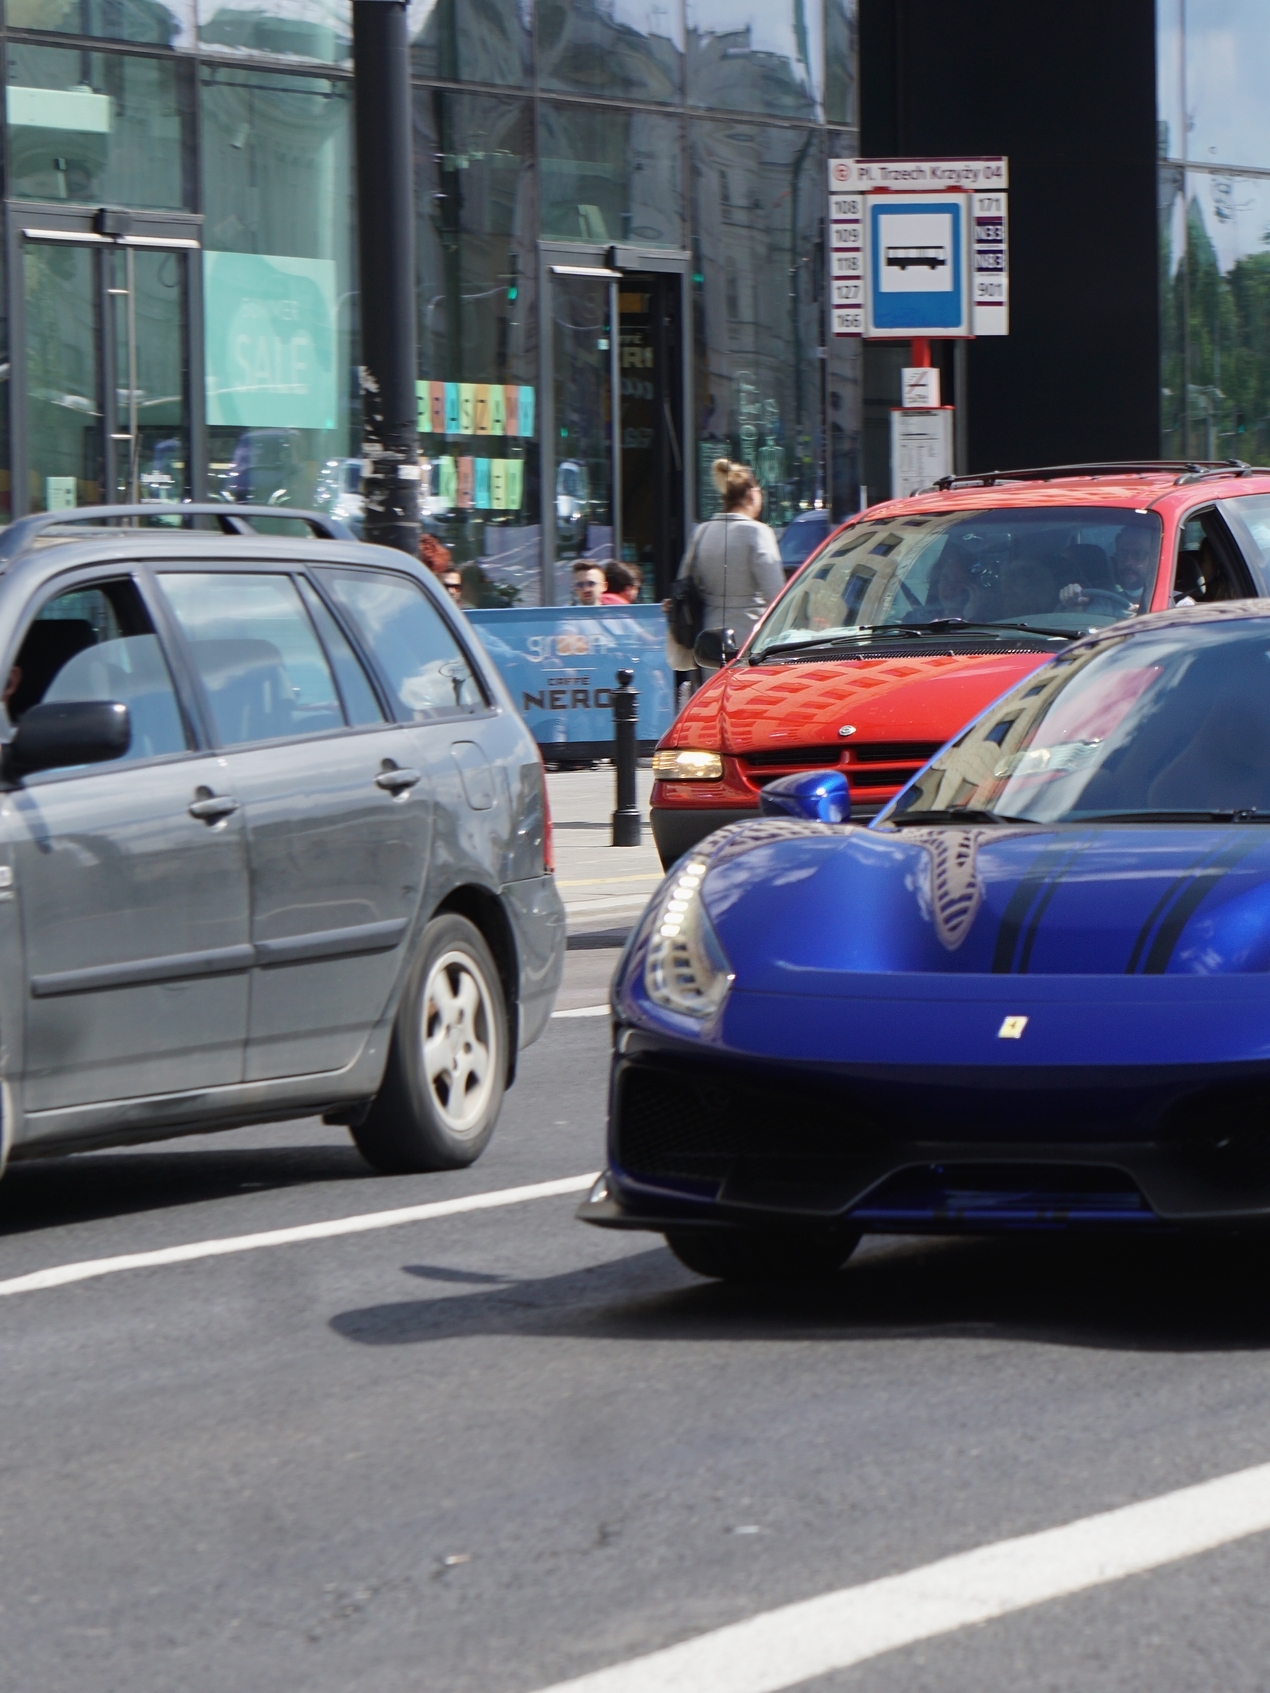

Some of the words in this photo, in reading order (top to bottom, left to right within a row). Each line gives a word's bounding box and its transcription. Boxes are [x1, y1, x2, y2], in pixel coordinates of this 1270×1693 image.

[878, 165, 928, 181] Trzech
[929, 164, 980, 183] Krzyży
[982, 165, 1004, 180] 04
[834, 199, 860, 215] 108
[977, 197, 1003, 212] 171
[835, 228, 861, 243] 109
[836, 257, 860, 271] 118
[835, 285, 861, 300] 127
[976, 282, 1004, 297] 901
[835, 314, 862, 329] 166
[235, 333, 308, 395] SALE
[522, 688, 615, 711] NERO
